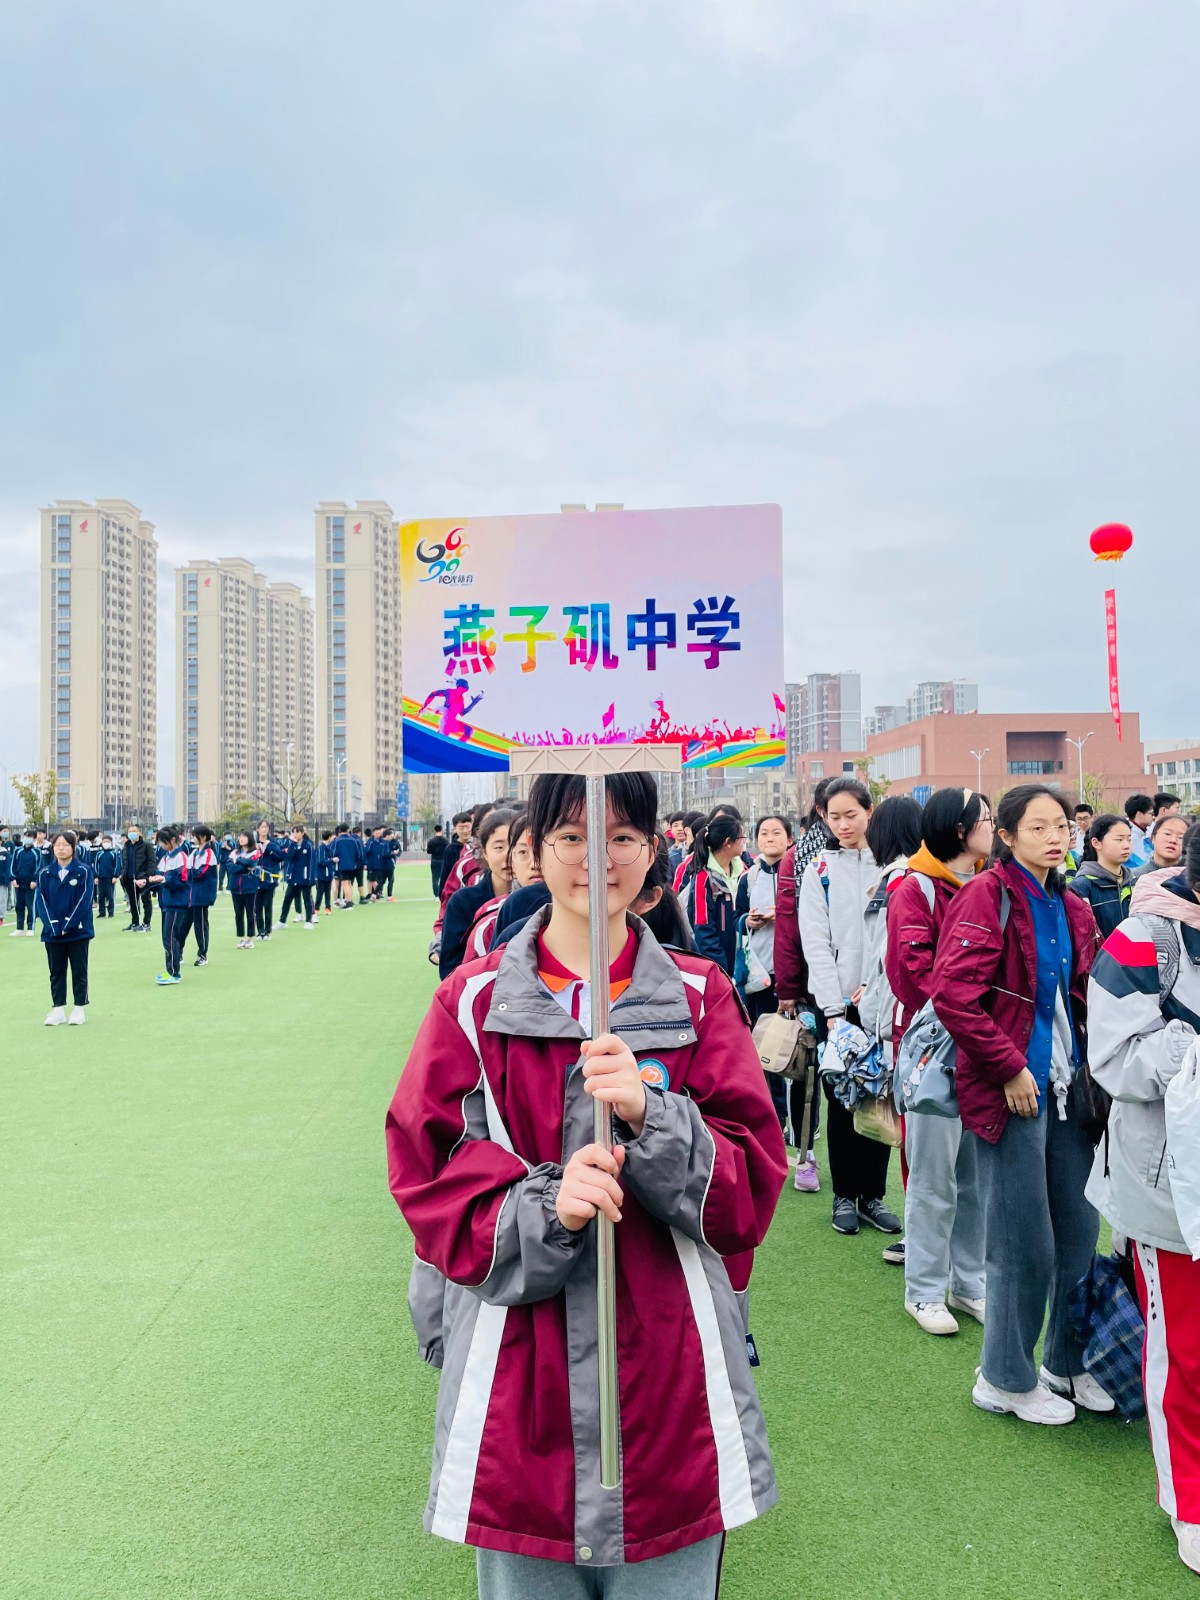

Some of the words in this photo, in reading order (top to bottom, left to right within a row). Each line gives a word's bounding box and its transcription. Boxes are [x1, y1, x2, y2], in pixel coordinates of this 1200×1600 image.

[442, 595, 742, 676] 燕子矶中学
